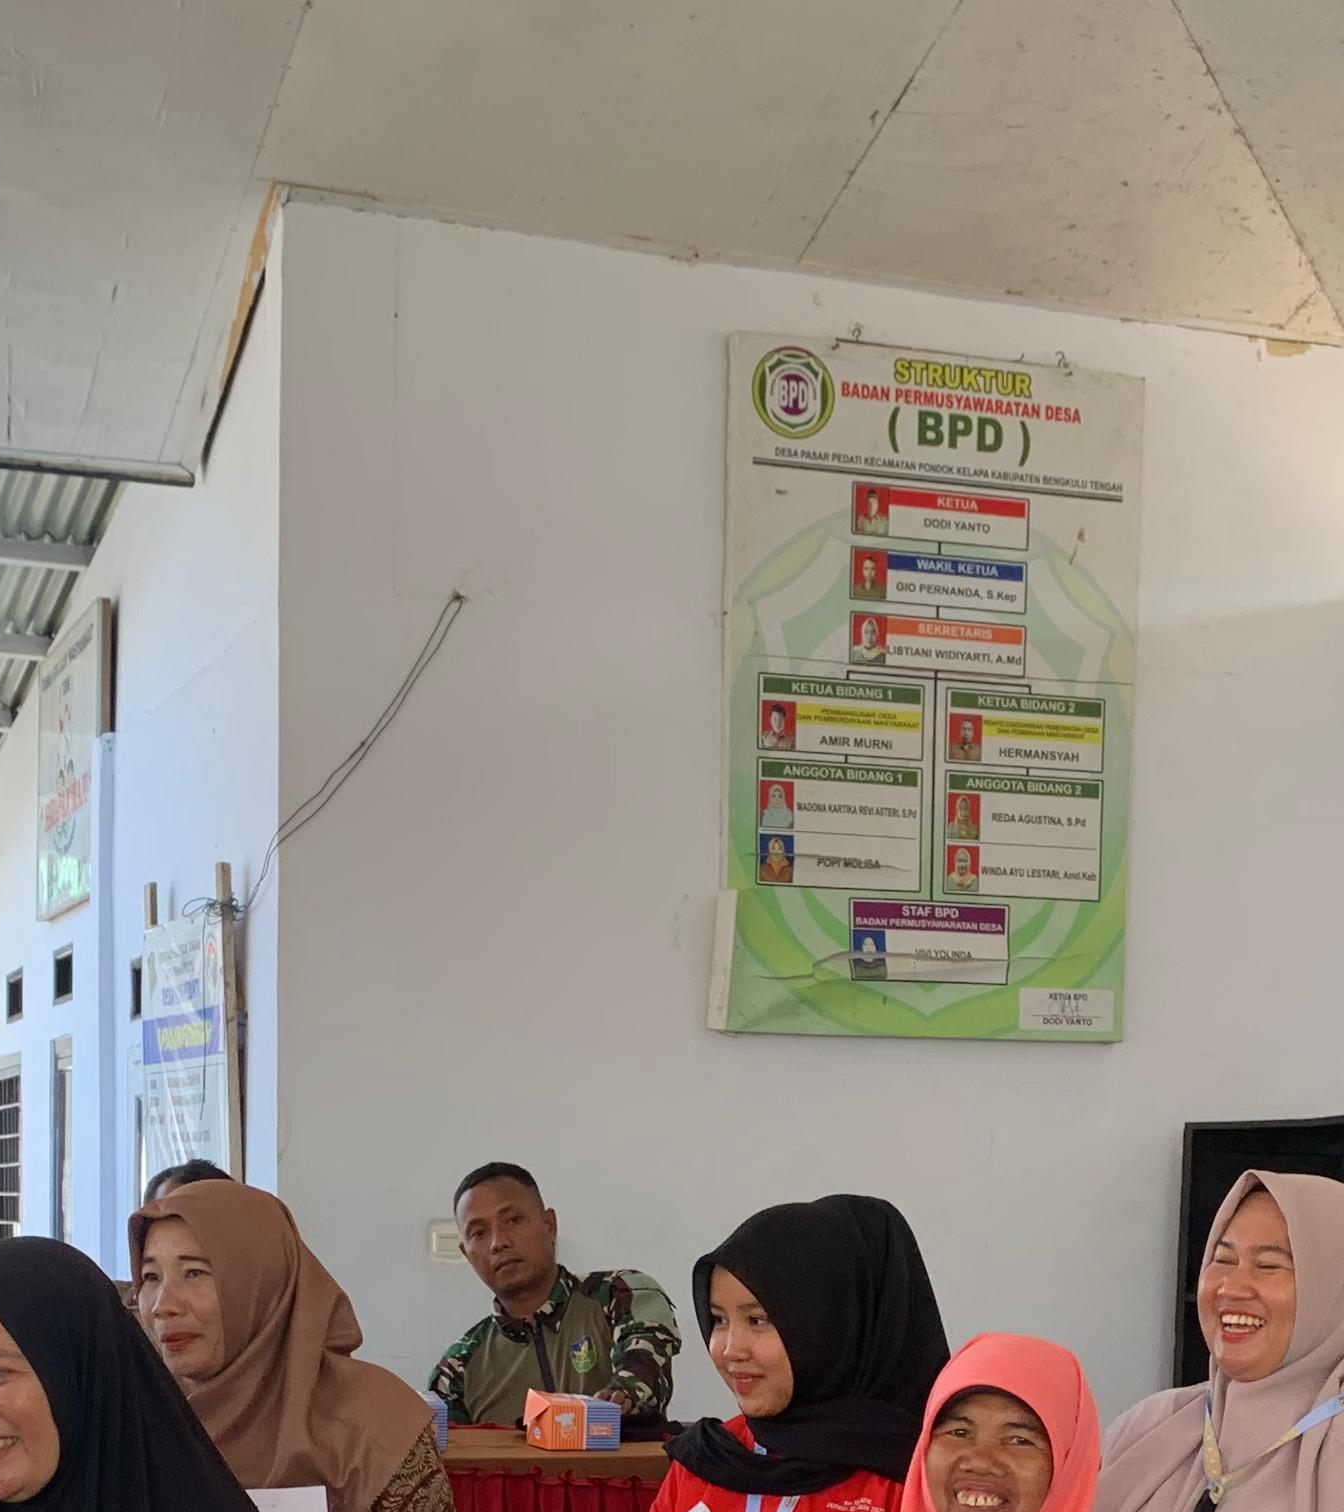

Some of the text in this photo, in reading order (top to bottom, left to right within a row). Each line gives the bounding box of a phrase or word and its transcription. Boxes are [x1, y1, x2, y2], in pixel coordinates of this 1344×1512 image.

[894, 357, 1032, 398] STRUKTUR
[778, 380, 807, 409] BPD
[841, 382, 1082, 424] BADAN PERMUSYAWARATAN DESA
[917, 409, 1004, 453] BPD
[775, 447, 1123, 492] DESA PASAR PEDATI KECAMATAN PONDOK KELAPA KABUPATEN BENGKULU TENGAH
[937, 496, 978, 510] KETUA
[924, 518, 990, 534] DODI YANTO
[917, 559, 999, 577] WAKIL KETUA
[896, 582, 1017, 604] GIO PERNANDA, S.Kep
[918, 624, 993, 640] SEKRETARIS
[887, 645, 1022, 666] LISTIANI WIDIYARTI, A.Md
[792, 682, 893, 700] KETUA BIDANG 1
[978, 696, 1076, 713] KETUA BIDANG 2
[820, 736, 893, 750] AMIR MURNI
[999, 748, 1080, 762] HERMANSYAH
[784, 765, 903, 783] ANGGOTA BIDANG 1
[966, 778, 1082, 796] ANGGOTA BIDANG 2
[796, 802, 826, 813] MADONA
[828, 804, 858, 814] KARTIKA
[992, 813, 1086, 828] REDA AGUSTINA, S.Pd
[817, 858, 841, 868] POPI
[982, 866, 1006, 876] WINDA
[1009, 868, 1024, 877] AYU
[902, 906, 960, 918] STAF BPD
[856, 917, 1003, 932] BADAN PERMUSYAWARATAN DESA
[1048, 992, 1072, 1001] KETUA
[1042, 1017, 1092, 1026] DODI YANTO
